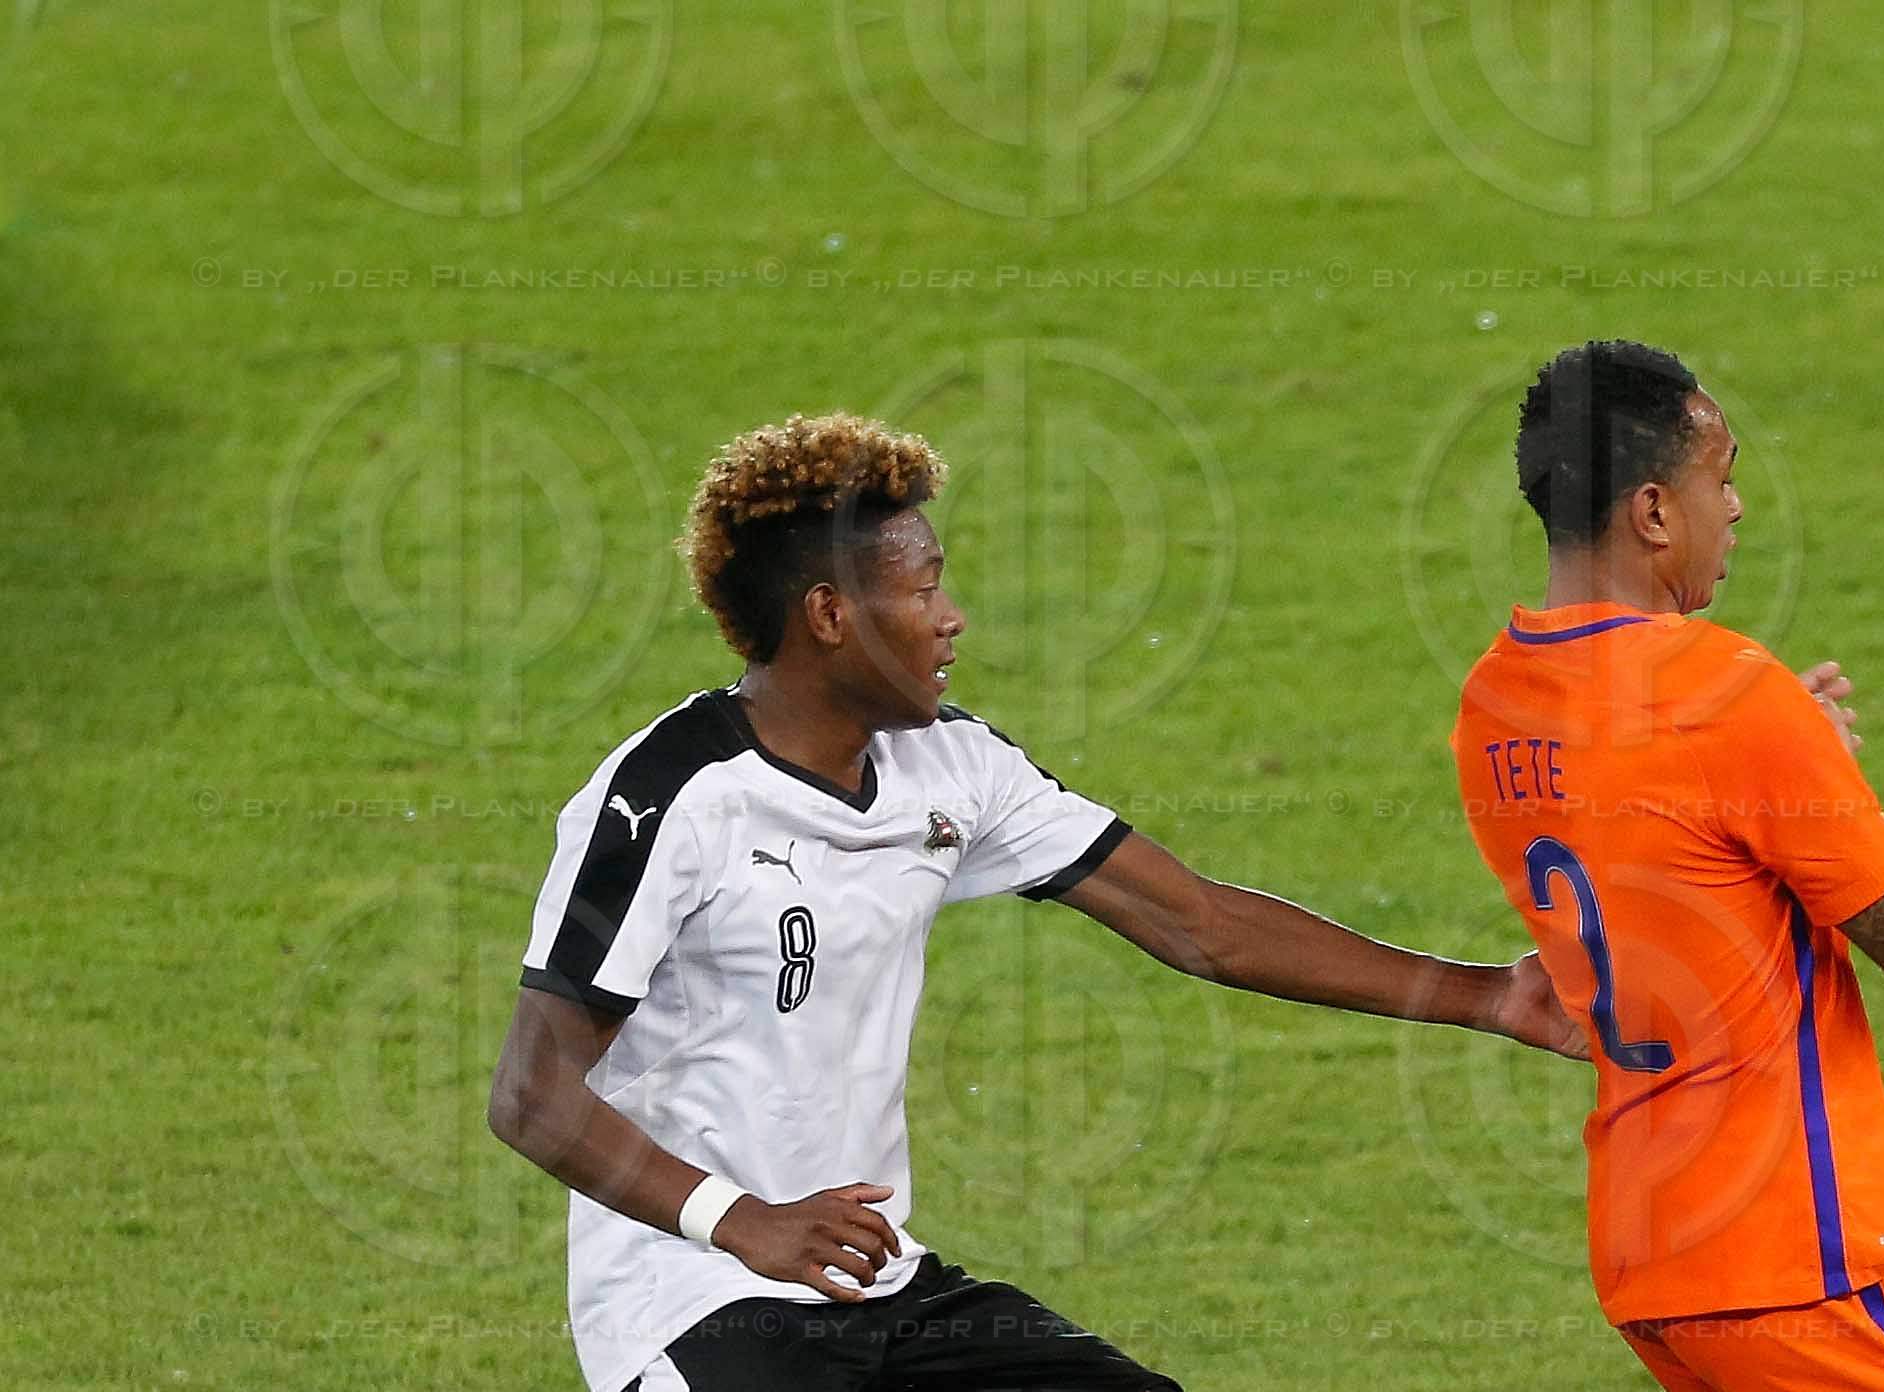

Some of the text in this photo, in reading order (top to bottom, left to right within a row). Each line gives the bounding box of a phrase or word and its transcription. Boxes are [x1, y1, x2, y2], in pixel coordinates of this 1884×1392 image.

[1486, 739, 1566, 802] TETE
[777, 905, 816, 1014] 8
[1525, 836, 1677, 1073] 2
